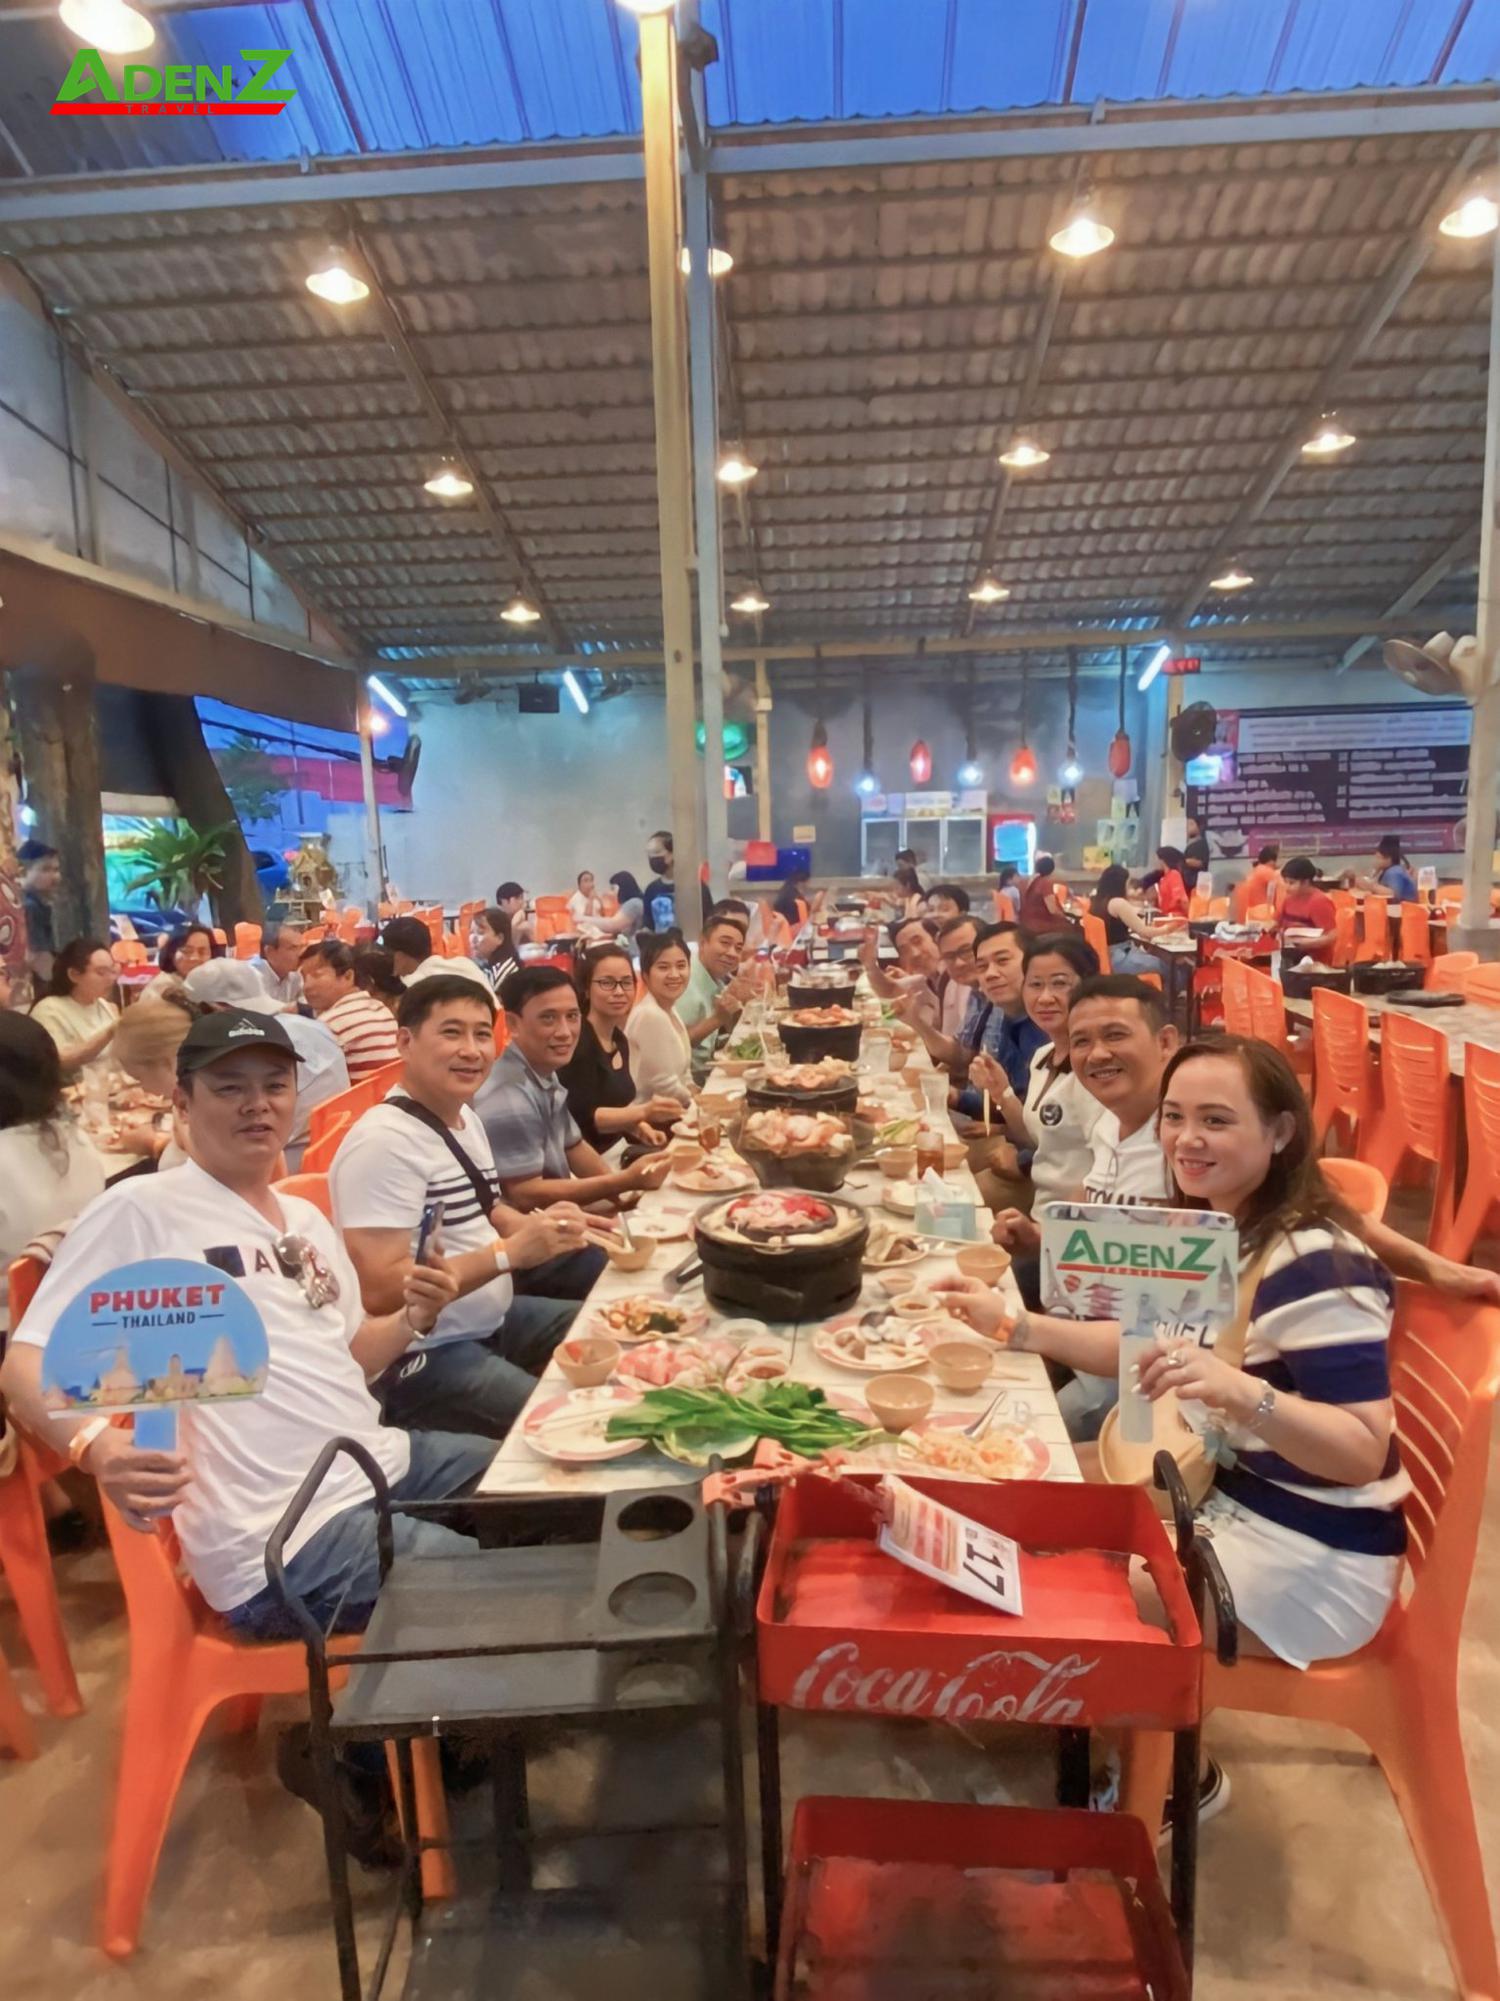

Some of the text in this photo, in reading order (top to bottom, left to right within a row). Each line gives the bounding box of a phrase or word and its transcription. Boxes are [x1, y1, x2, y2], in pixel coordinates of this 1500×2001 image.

[1060, 1229, 1216, 1272] ADENZ
[90, 1284, 226, 1314] PHUKET
[121, 1311, 196, 1329] THAILAND
[962, 1543, 1005, 1597] 17
